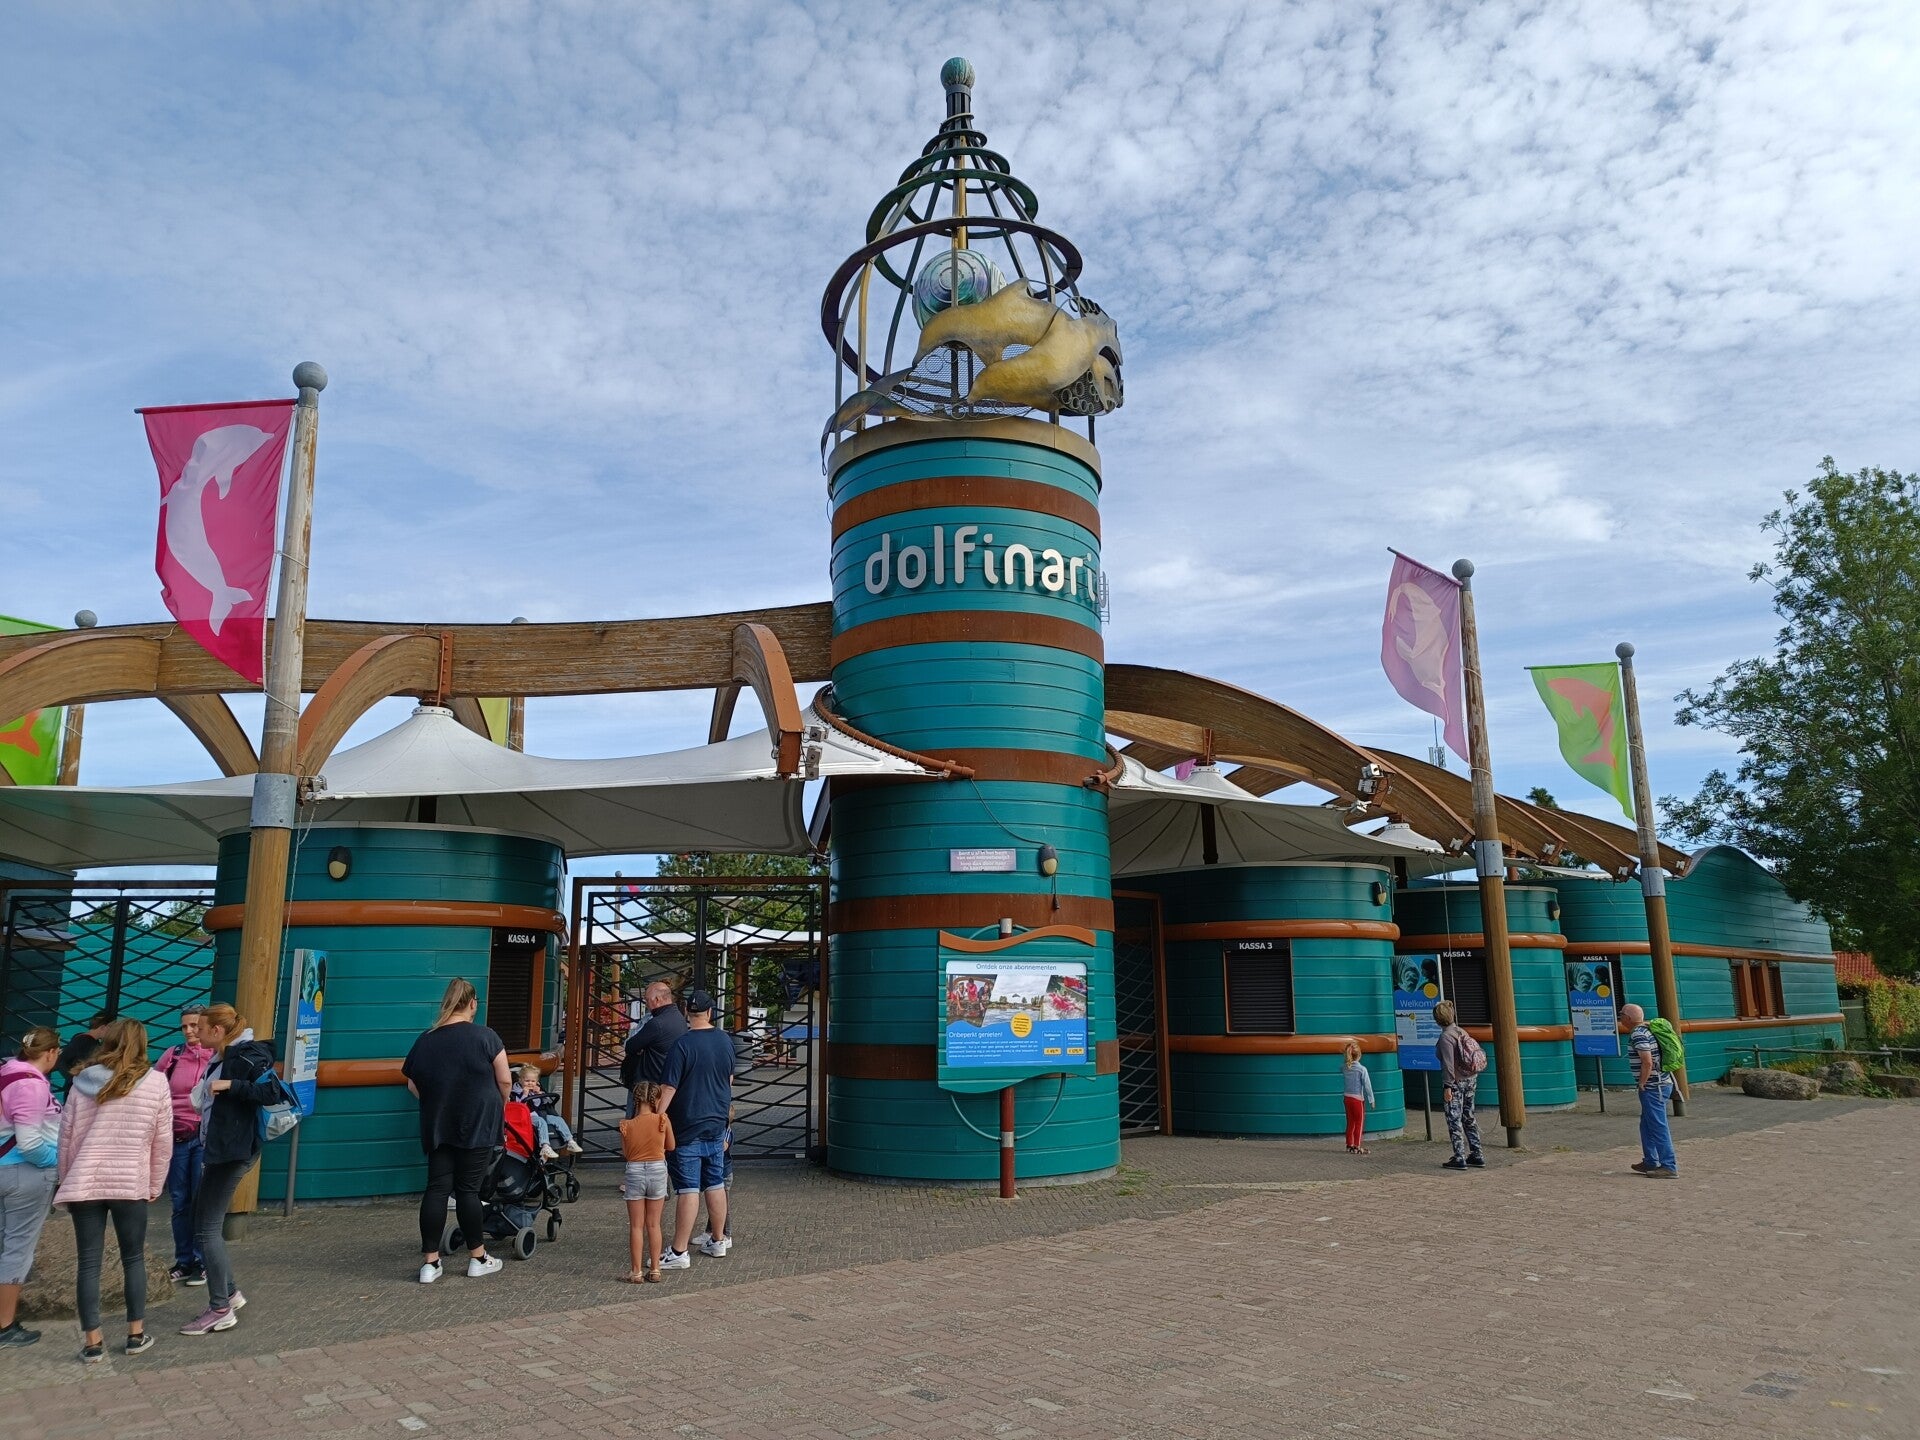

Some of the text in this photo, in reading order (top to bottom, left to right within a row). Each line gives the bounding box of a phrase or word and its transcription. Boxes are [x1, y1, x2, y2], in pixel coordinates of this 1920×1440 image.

[508, 934, 536, 944] KASSA 4
[1239, 942, 1273, 950] KASSA 3
[1400, 999, 1434, 1008] Welkom!
[1575, 998, 1607, 1006] Welkom!
